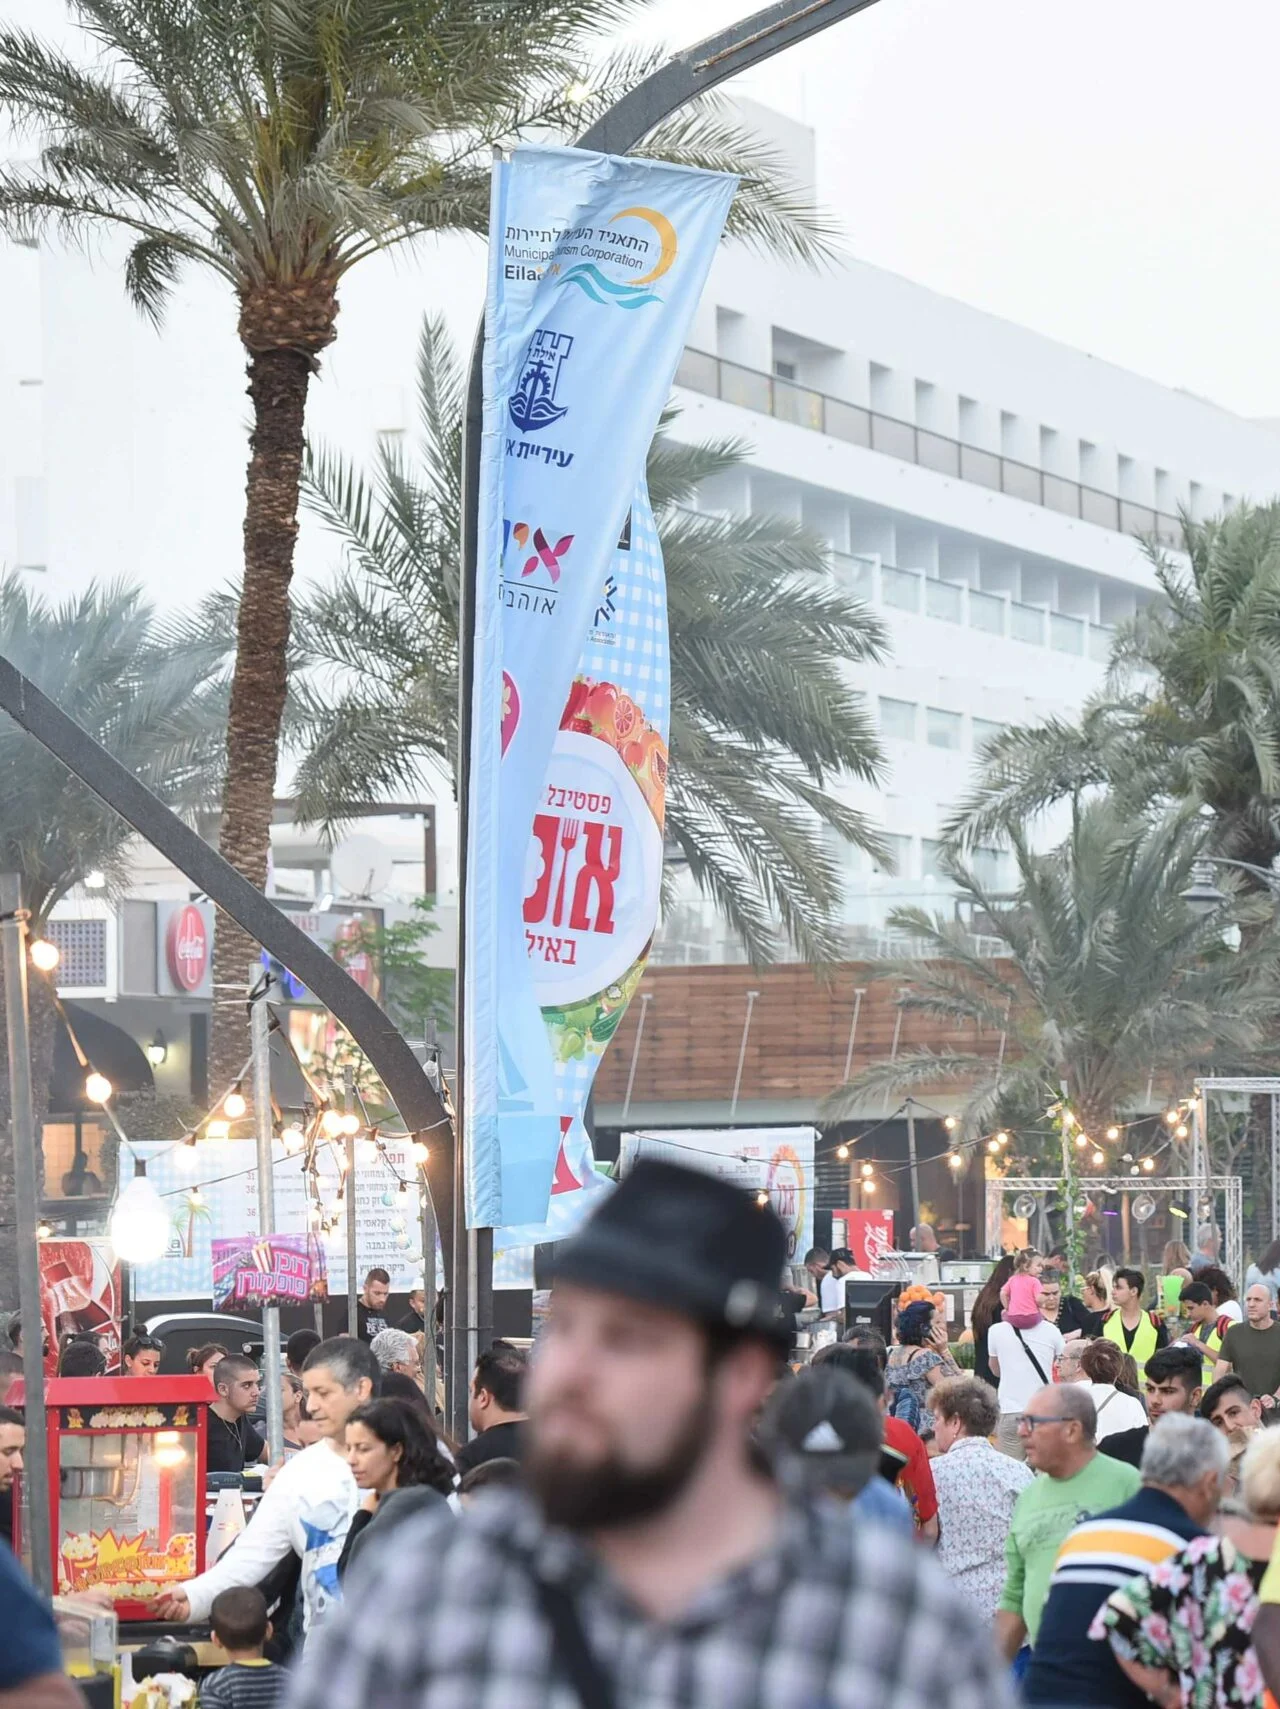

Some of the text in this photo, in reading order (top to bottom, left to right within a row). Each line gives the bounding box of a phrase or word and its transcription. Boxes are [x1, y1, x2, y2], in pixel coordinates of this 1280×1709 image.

[505, 226, 561, 243] לתיירות
[598, 229, 649, 253] התאגיד
[504, 244, 554, 262] Municipa
[580, 245, 643, 270] Corporation
[532, 346, 556, 361] אילת
[516, 441, 575, 468] עיריית
[547, 784, 612, 814] פסטיבל
[522, 813, 623, 934] אוכ
[525, 929, 577, 965] באיל
[274, 1251, 309, 1277] דוכן
[237, 1271, 307, 1297] פופקורן
